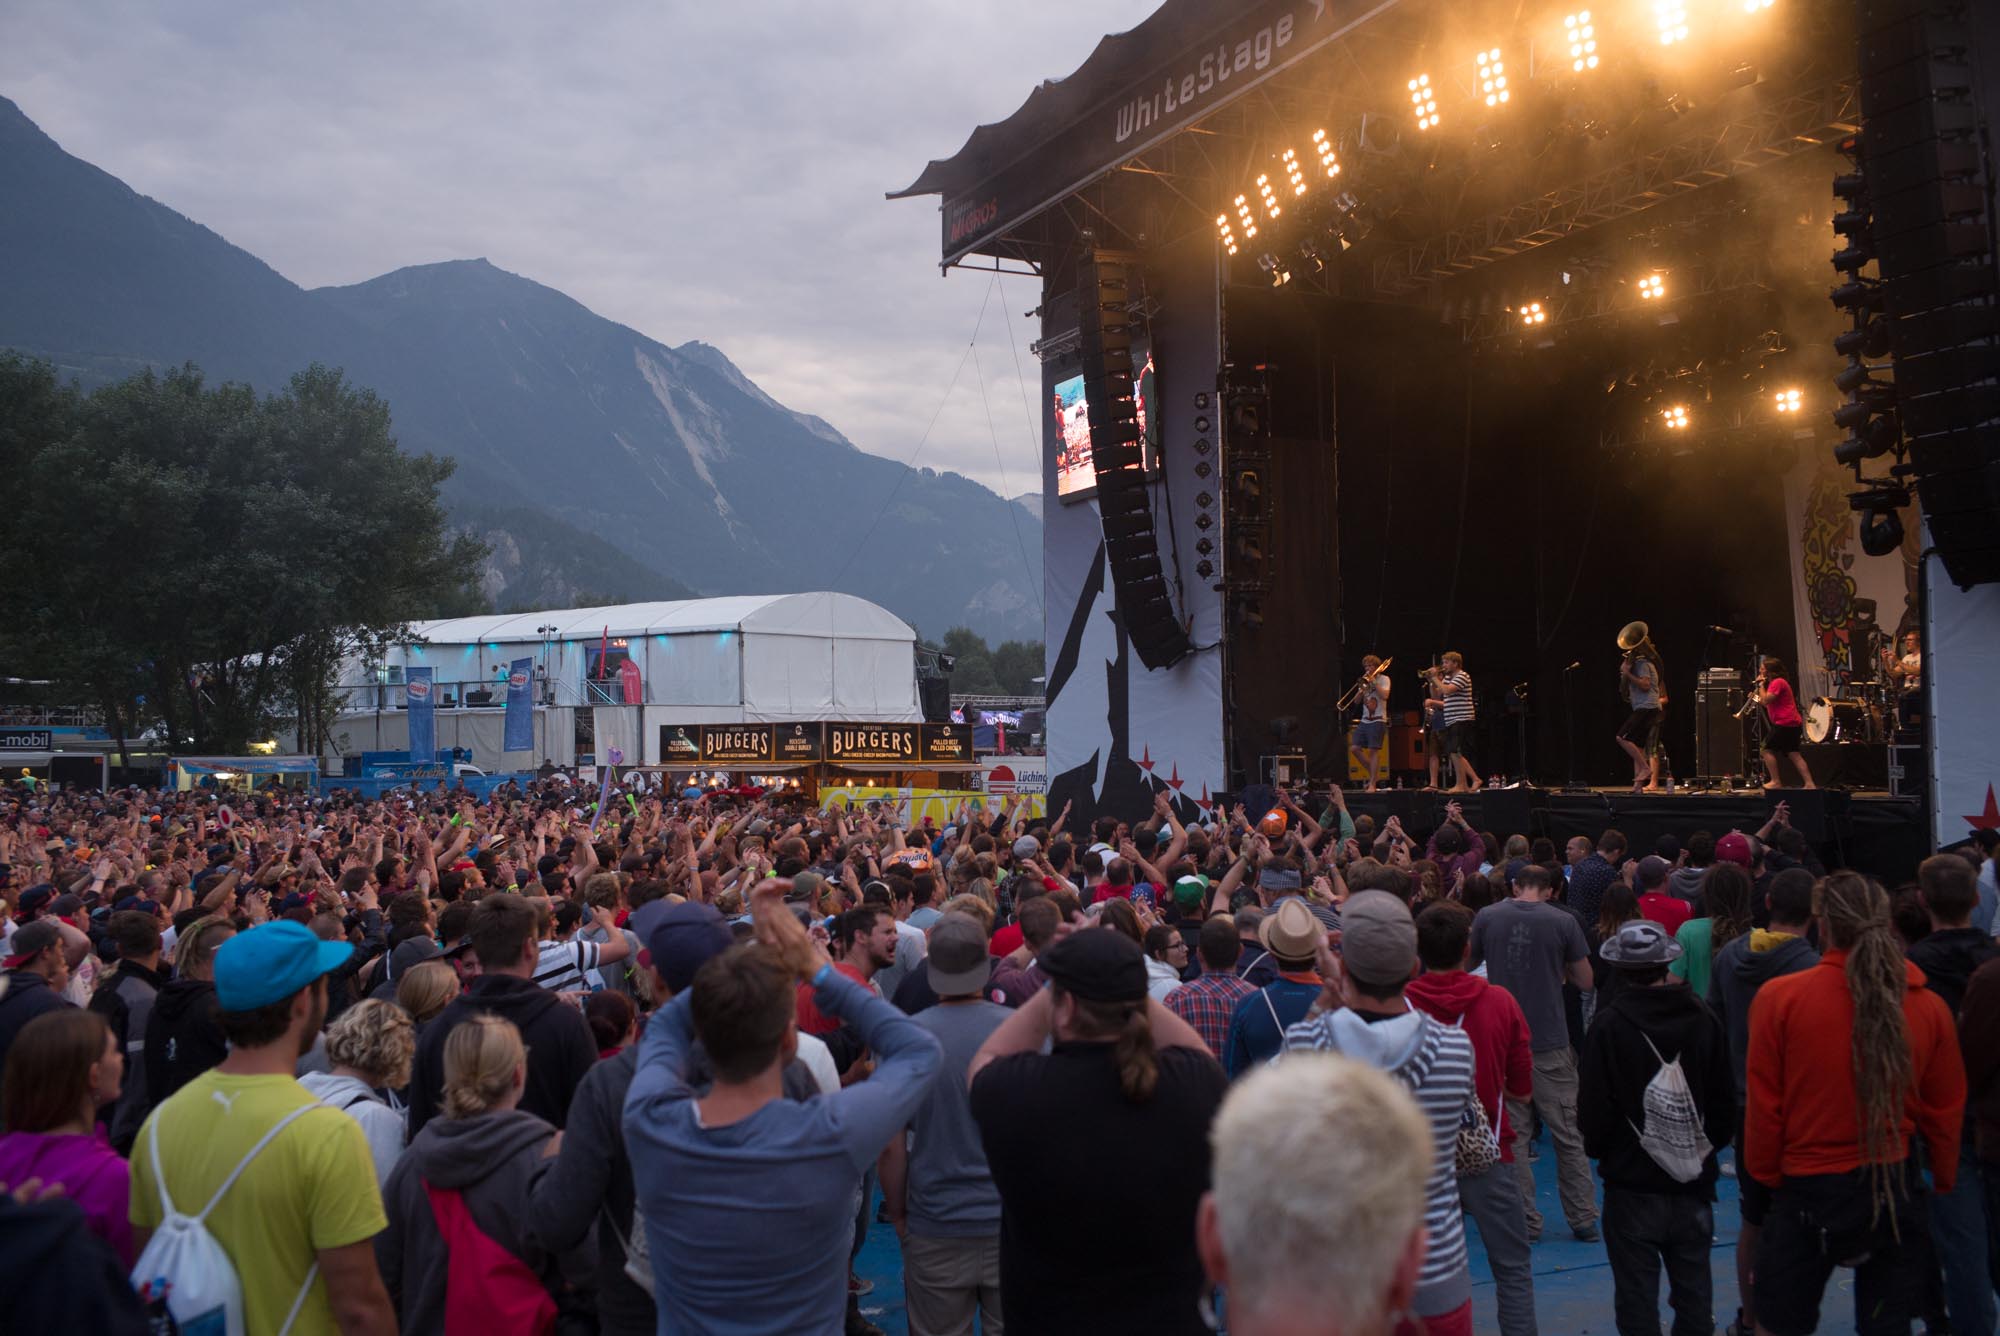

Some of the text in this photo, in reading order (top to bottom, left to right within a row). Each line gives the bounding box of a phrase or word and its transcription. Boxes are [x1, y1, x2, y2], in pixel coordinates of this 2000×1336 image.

[1115, 13, 1294, 143] WhiteStage
[706, 732, 768, 755] BURGERS
[833, 731, 912, 755] BURGERS
